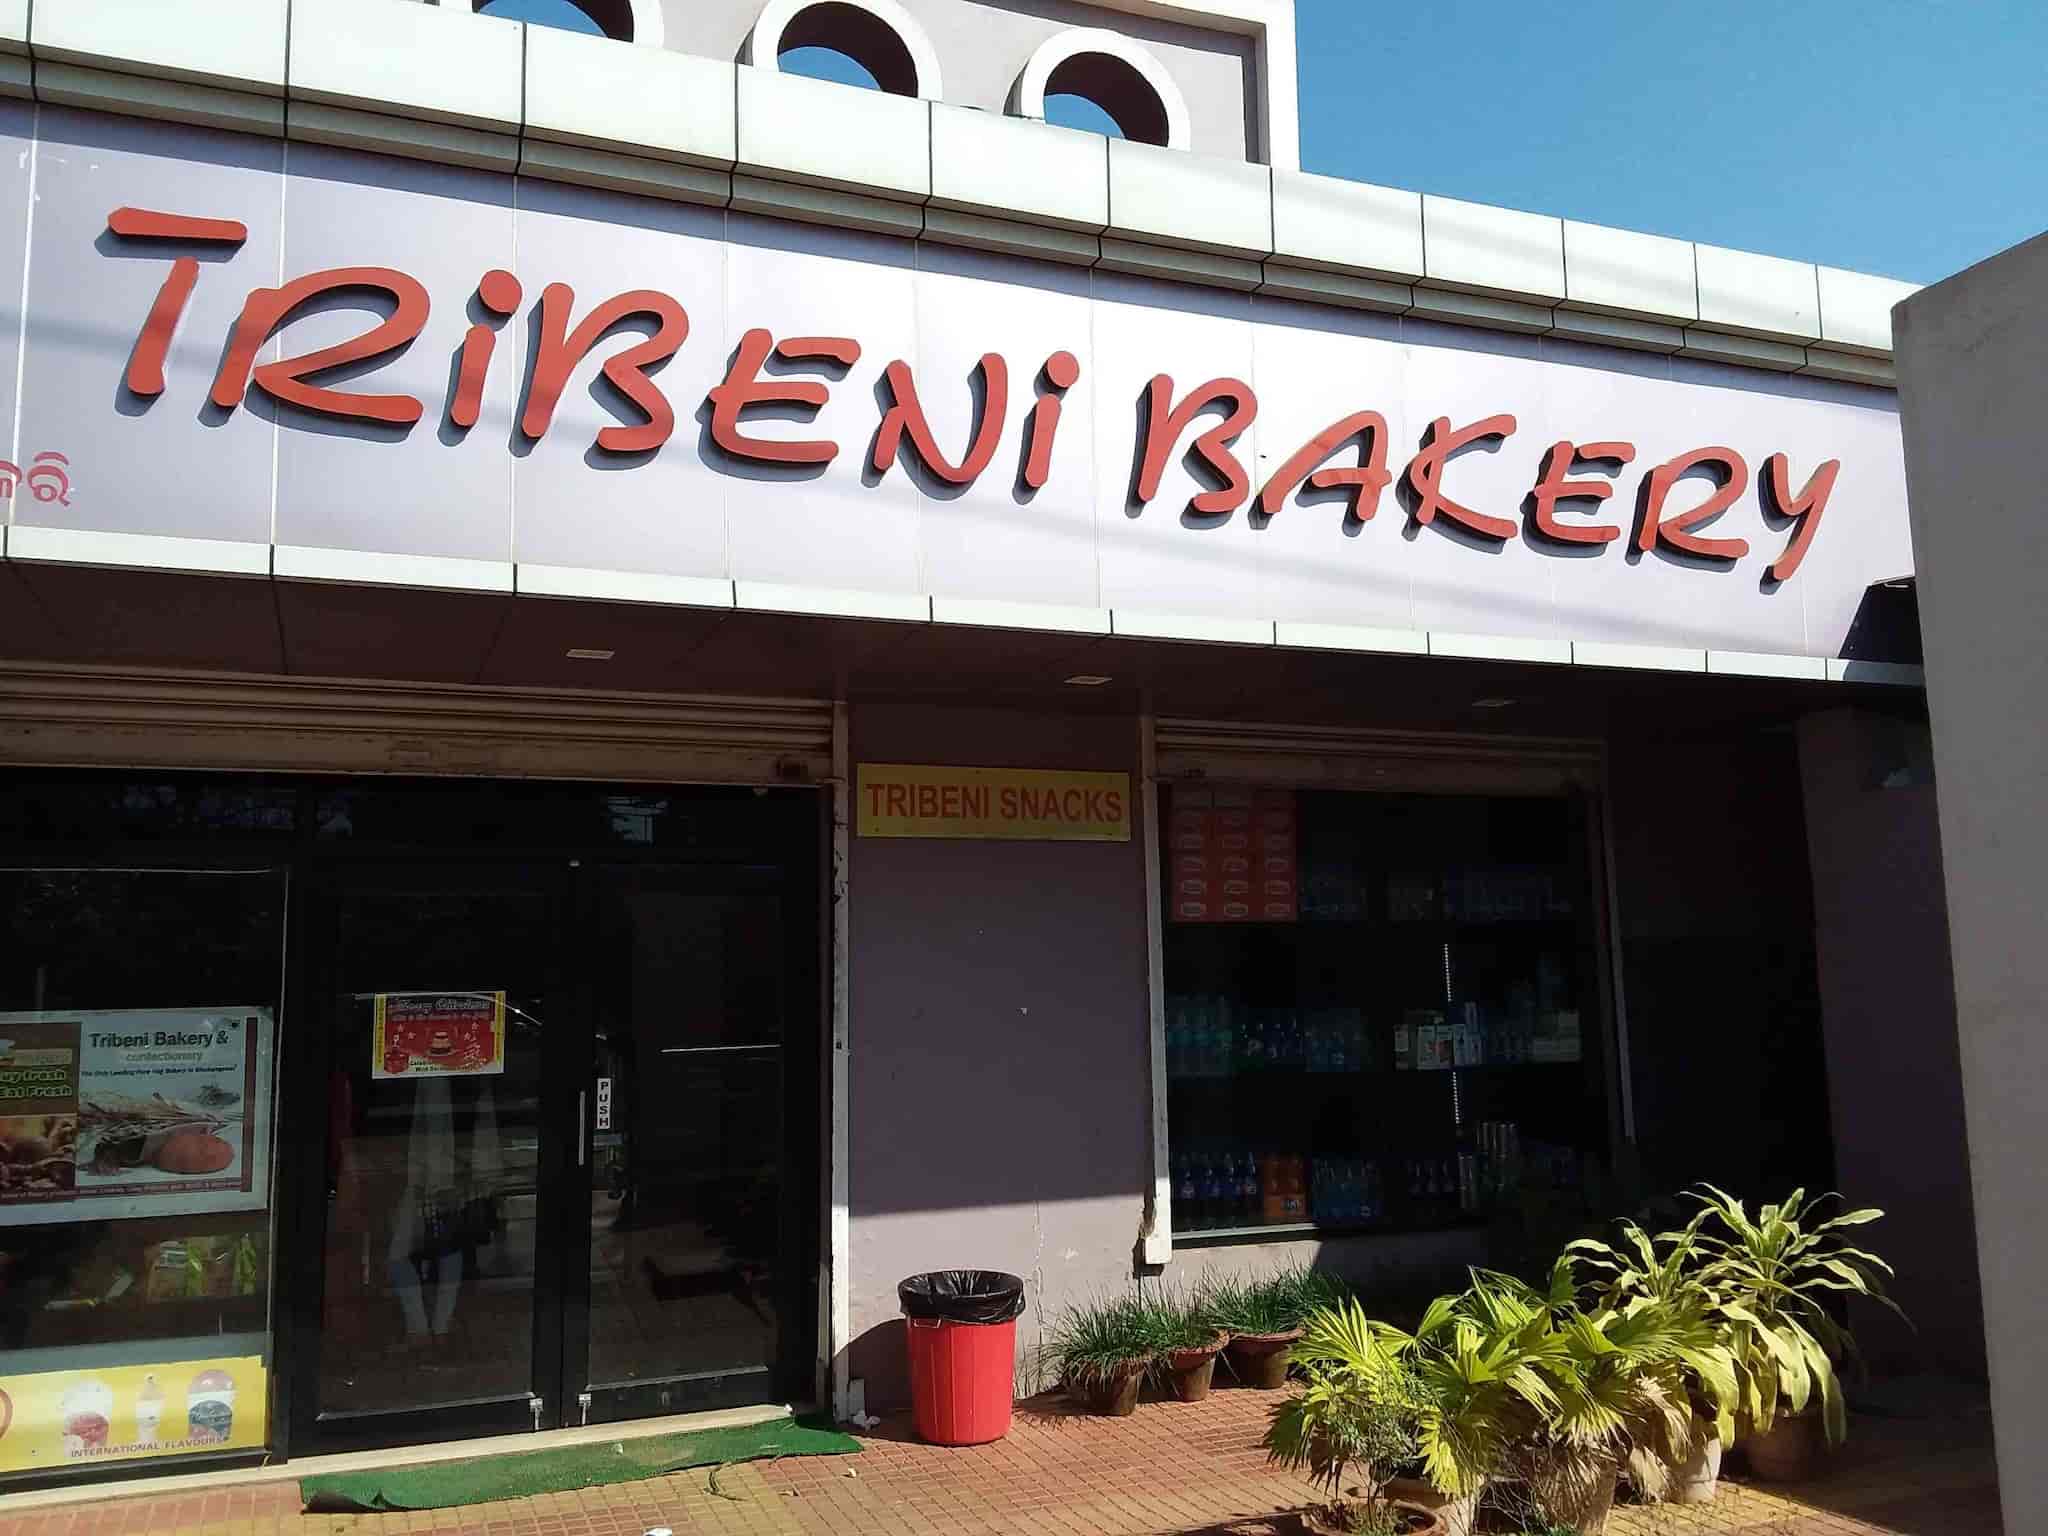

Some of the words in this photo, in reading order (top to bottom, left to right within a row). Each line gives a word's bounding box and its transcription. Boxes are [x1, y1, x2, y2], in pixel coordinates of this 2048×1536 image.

[1133, 374, 1838, 588] BAKERY
[865, 783, 990, 819] TRIBENI
[999, 787, 1123, 823] SNACKS
[89, 1032, 149, 1048] Tribeni
[154, 1031, 213, 1049] Bakery
[216, 1030, 229, 1044] &
[599, 1081, 609, 1127] PUSH
[71, 1442, 161, 1458] INTERNATIONAL
